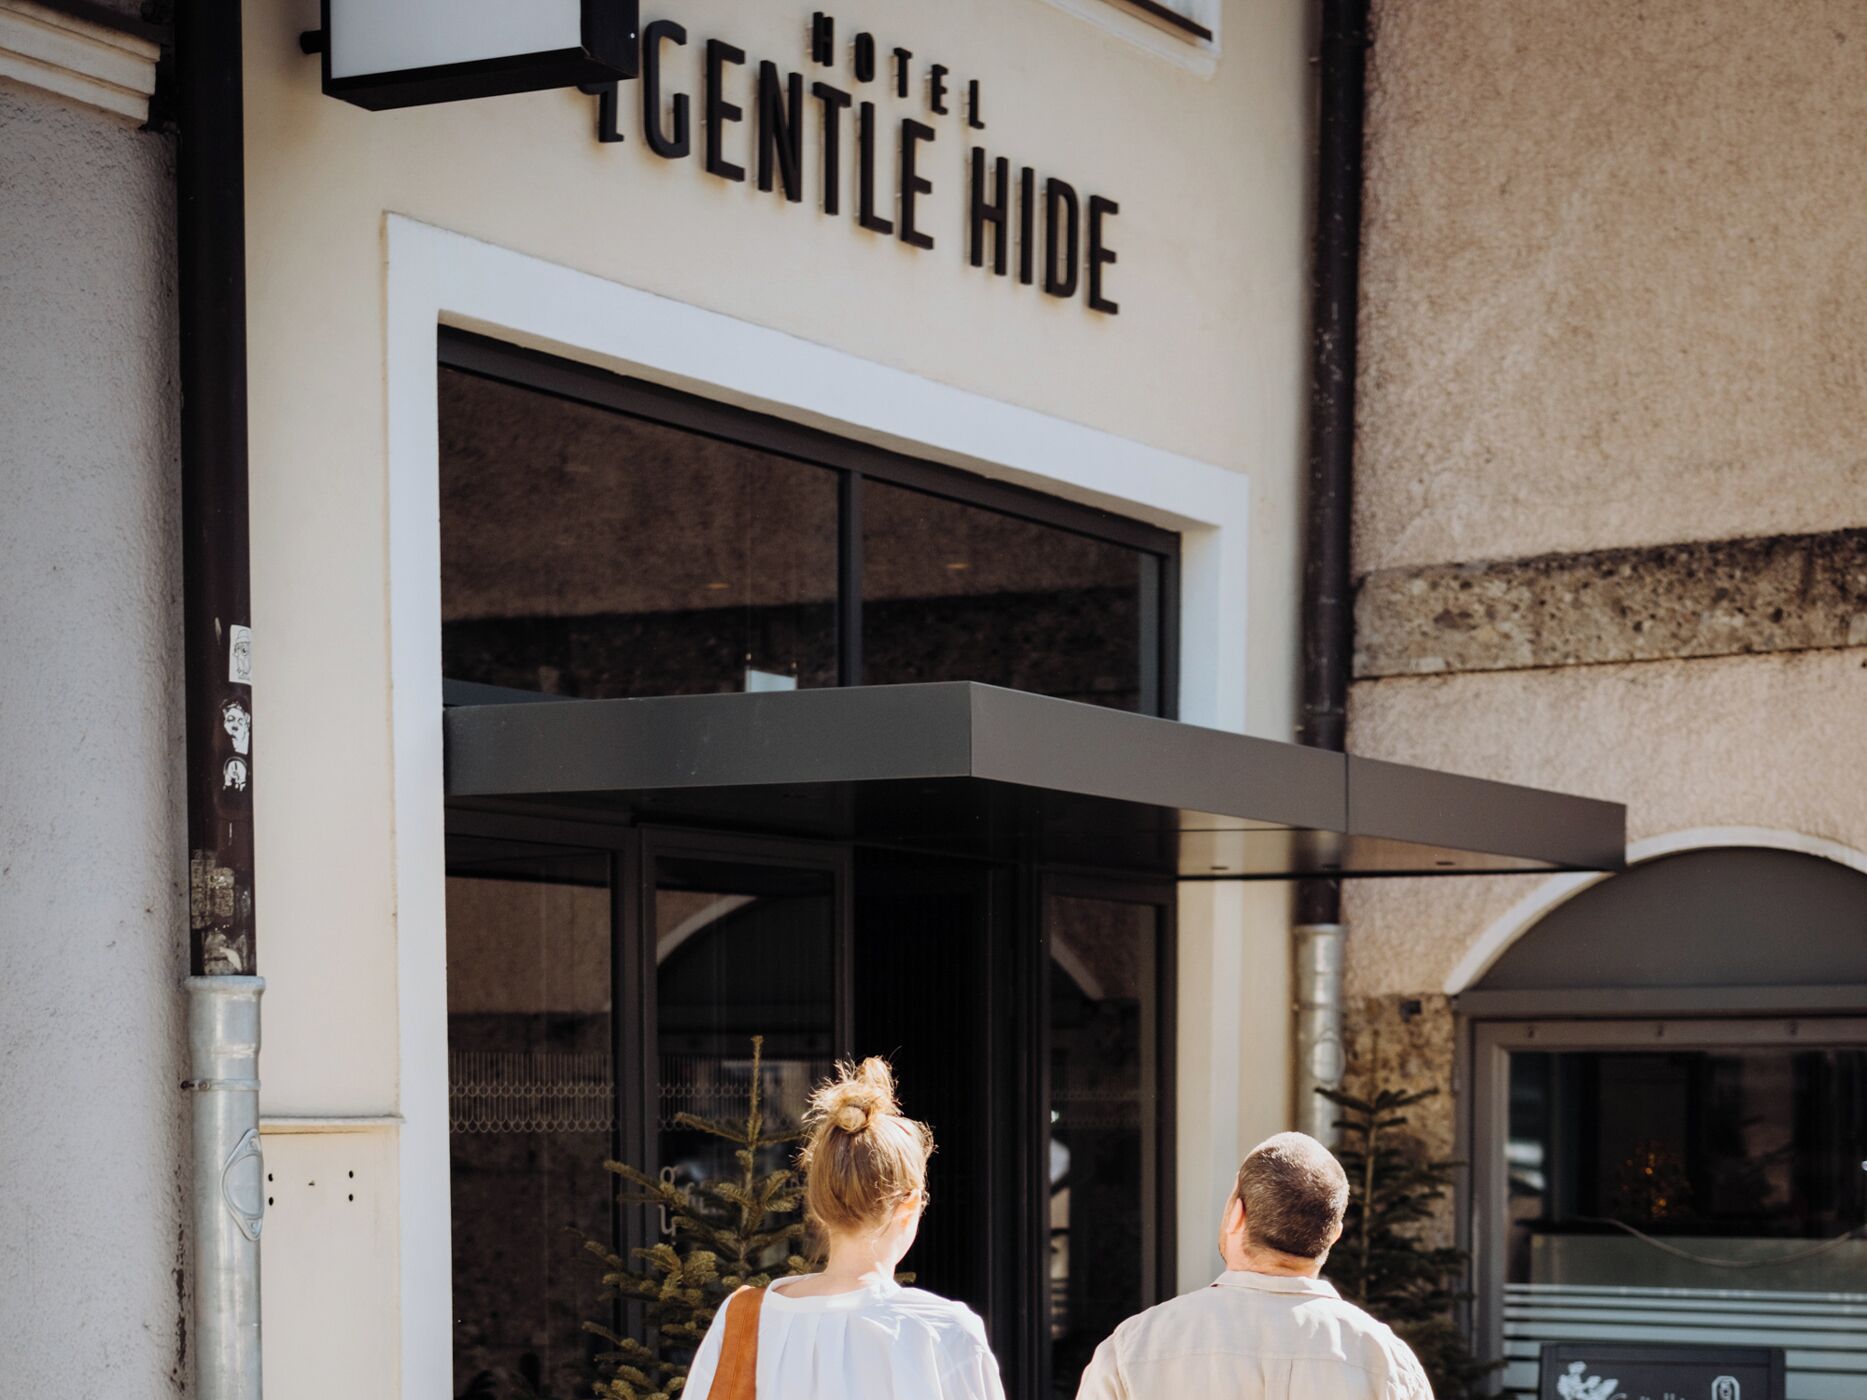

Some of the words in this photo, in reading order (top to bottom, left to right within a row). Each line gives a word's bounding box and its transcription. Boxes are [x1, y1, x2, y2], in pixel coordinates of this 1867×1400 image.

[643, 19, 935, 250] GENTLE
[971, 146, 1119, 315] HIDE
[812, 11, 984, 130] HOTEL
